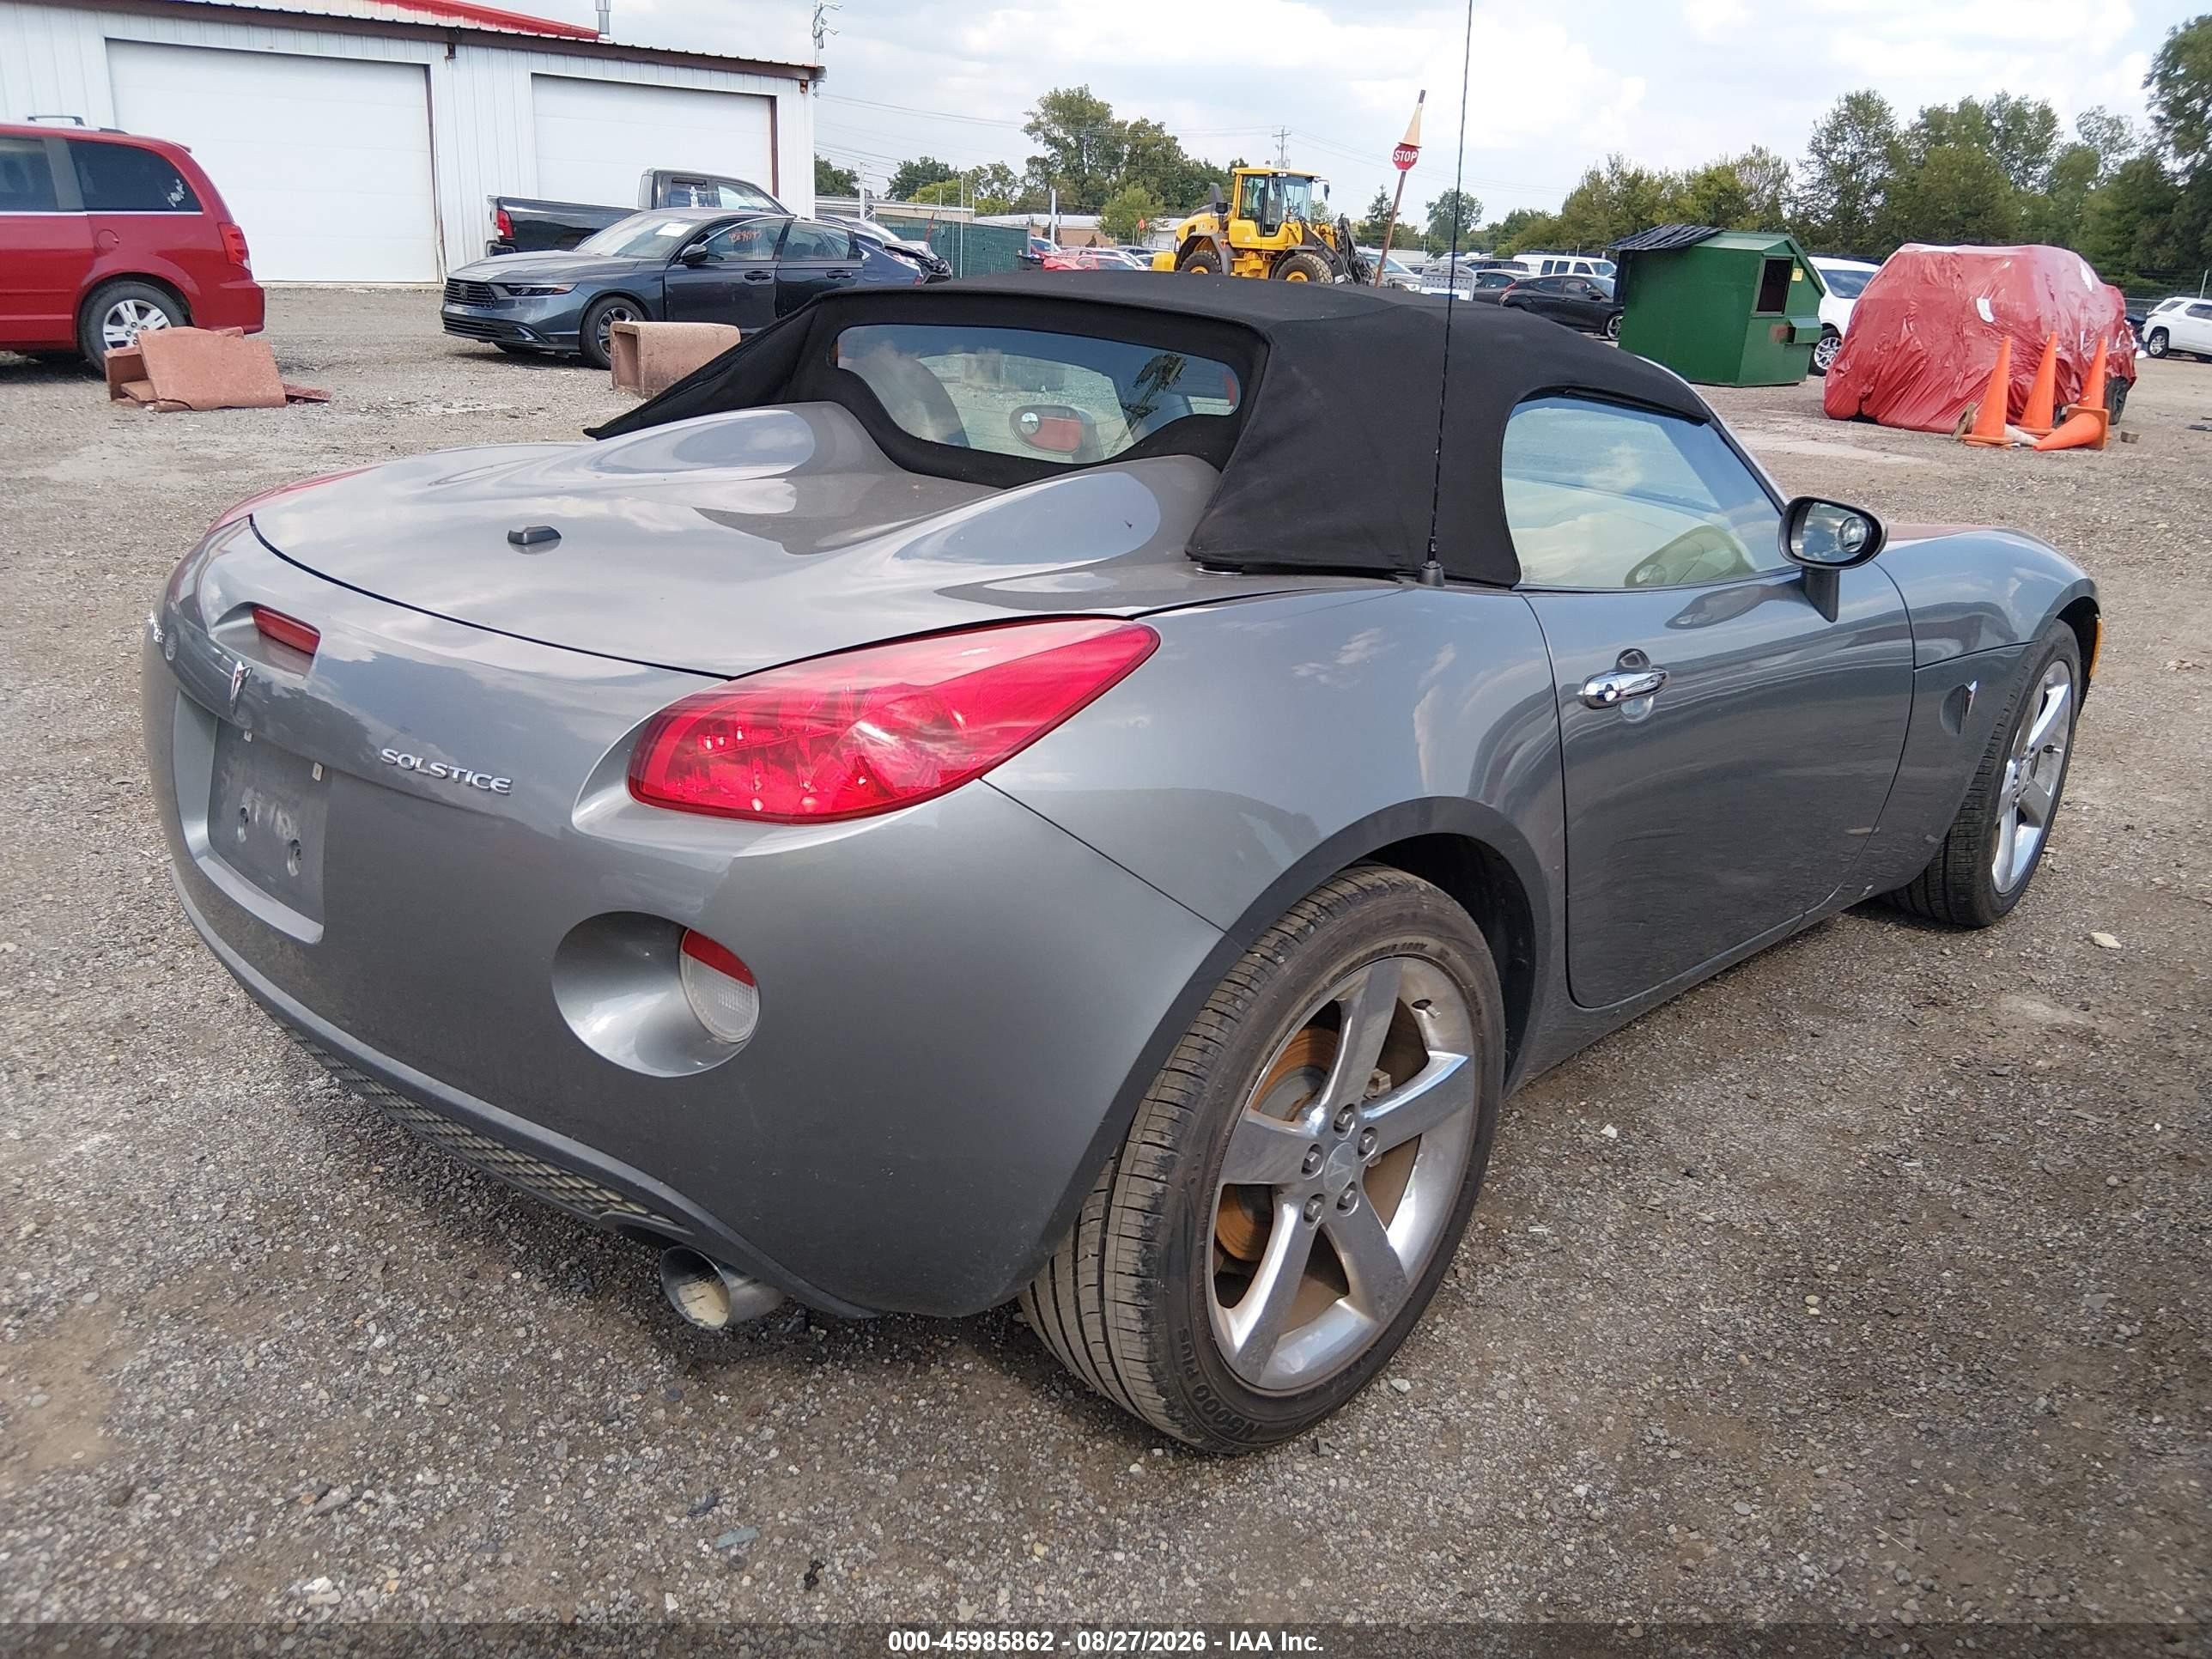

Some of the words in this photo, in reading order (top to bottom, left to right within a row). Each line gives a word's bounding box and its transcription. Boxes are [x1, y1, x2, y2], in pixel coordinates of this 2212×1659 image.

[1394, 149, 1418, 162] STOP
[380, 748, 512, 795] SOLSTICE
[1194, 1382, 1262, 1439] N5000
